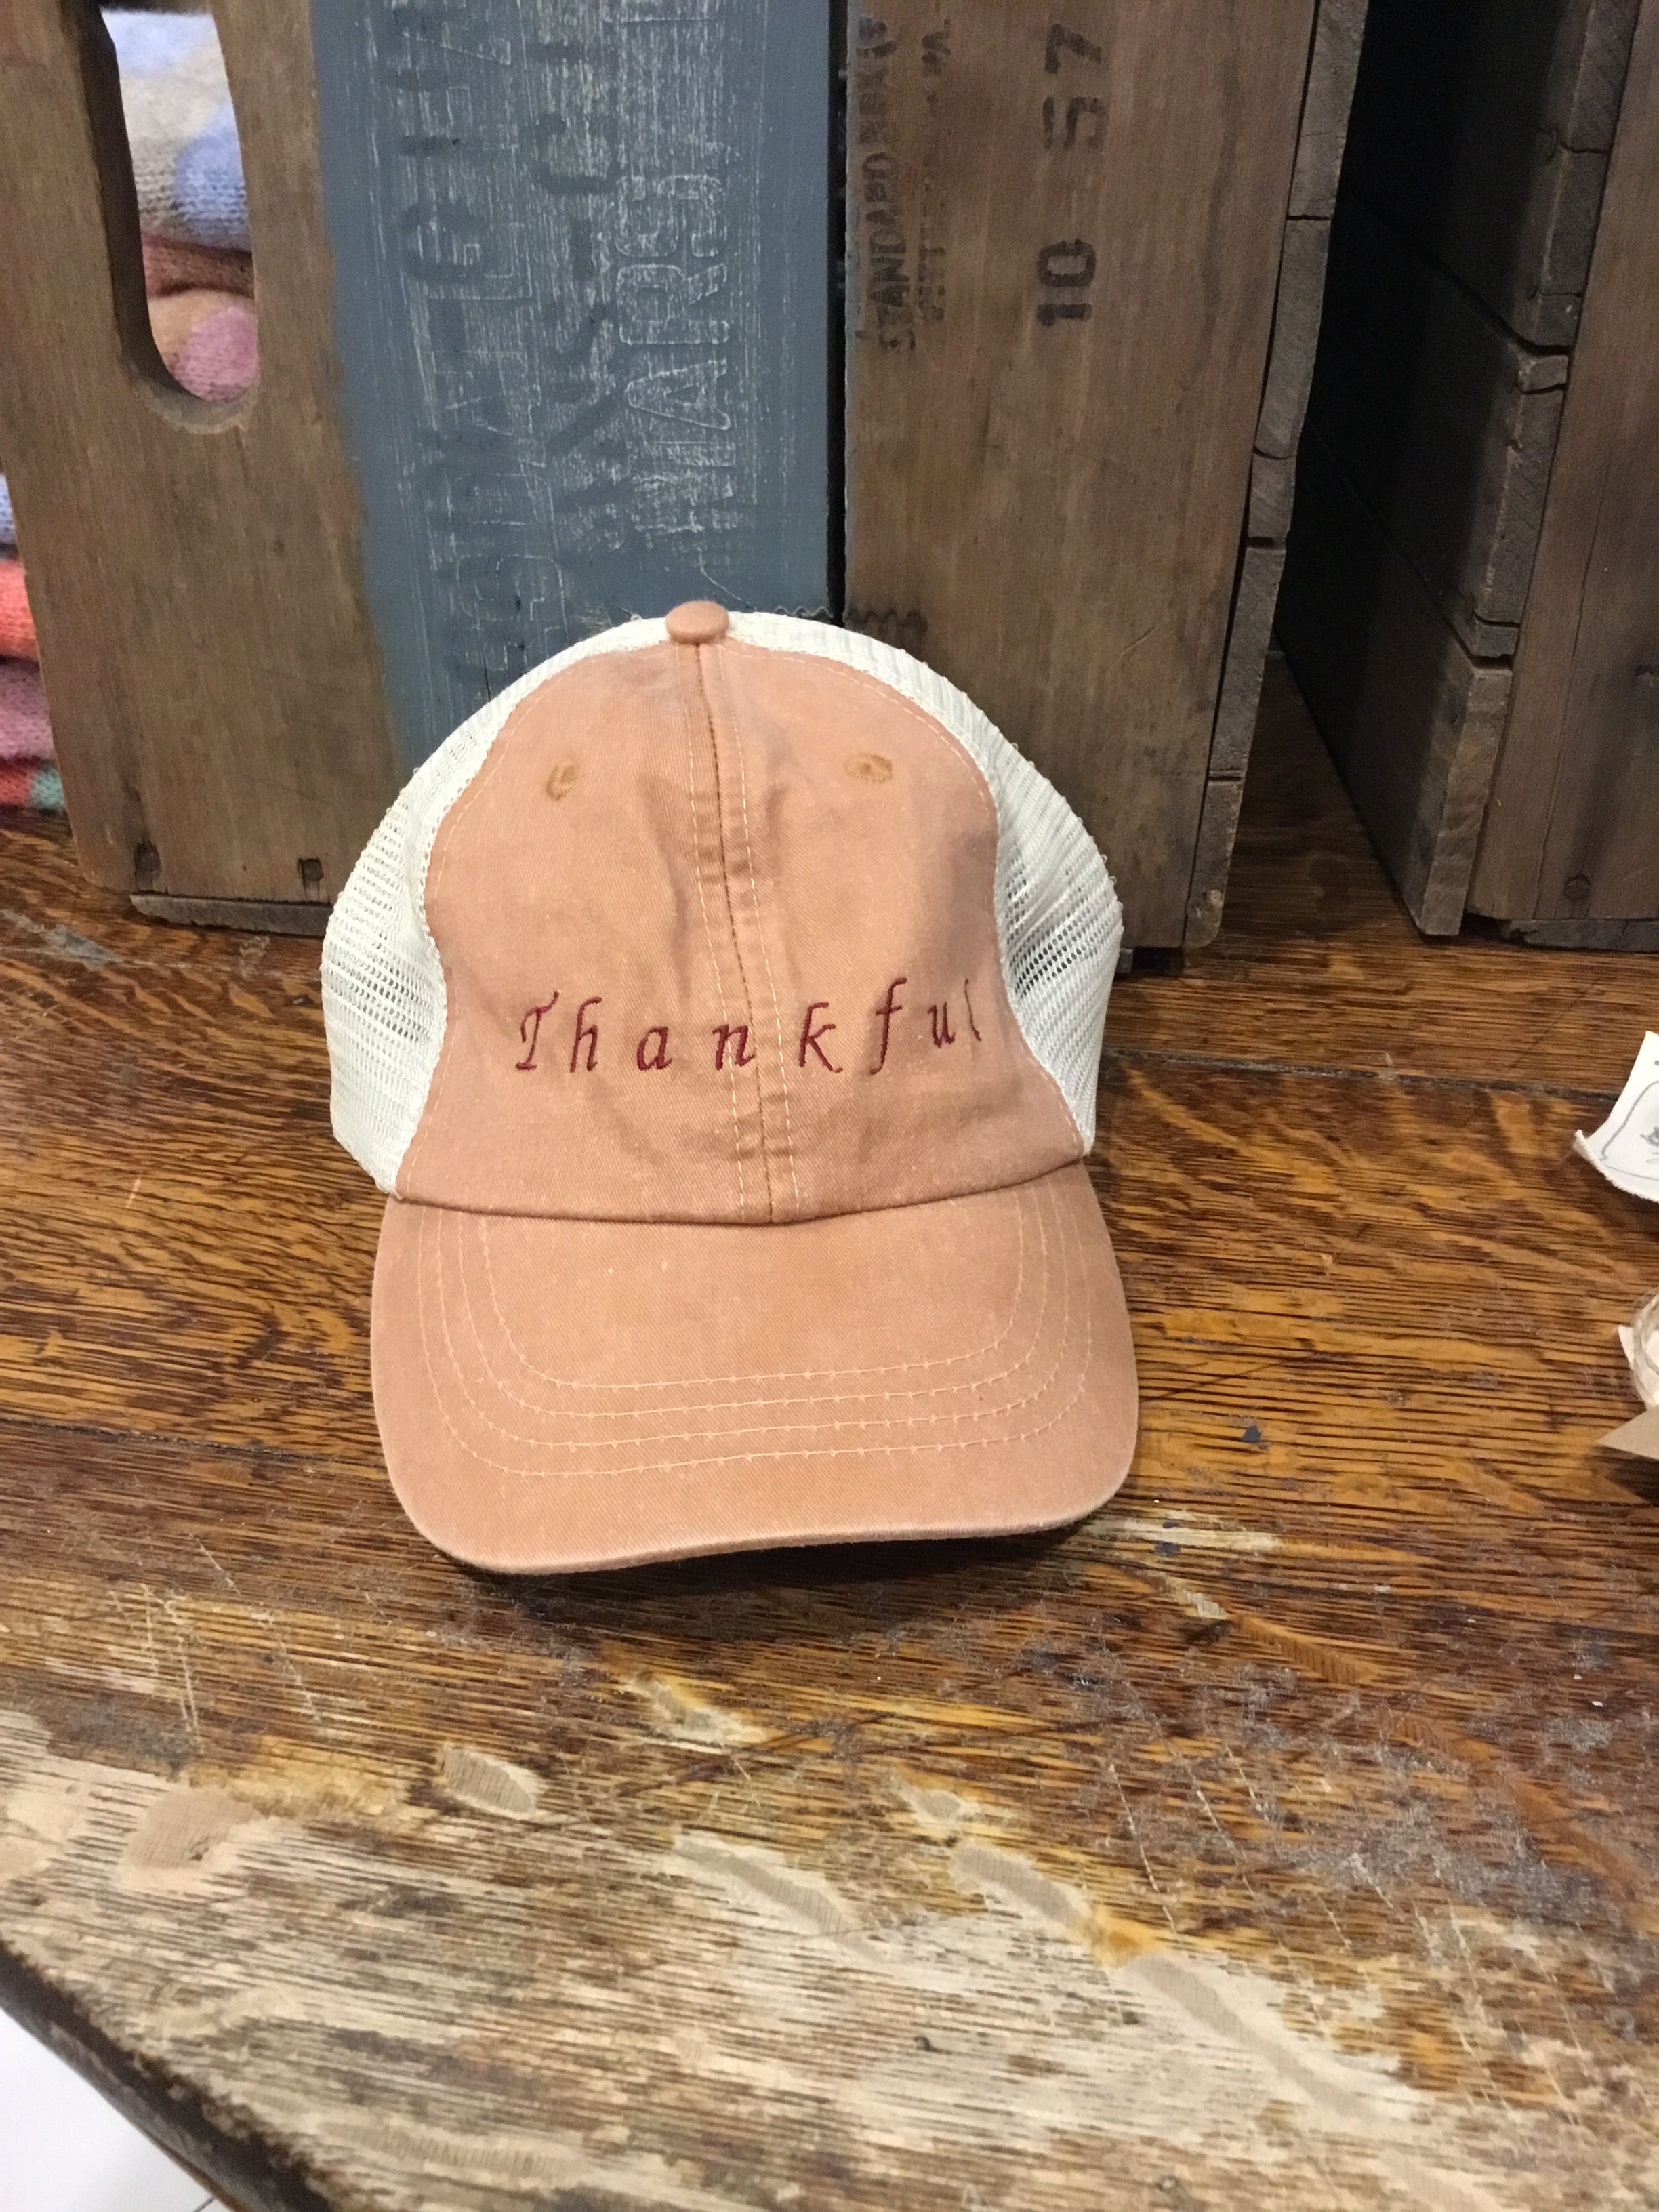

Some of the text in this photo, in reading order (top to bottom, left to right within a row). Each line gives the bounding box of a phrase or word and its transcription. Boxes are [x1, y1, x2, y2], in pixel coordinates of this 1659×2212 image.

[1036, 22, 1108, 327] 10 57
[515, 977, 983, 1075] Thankful
